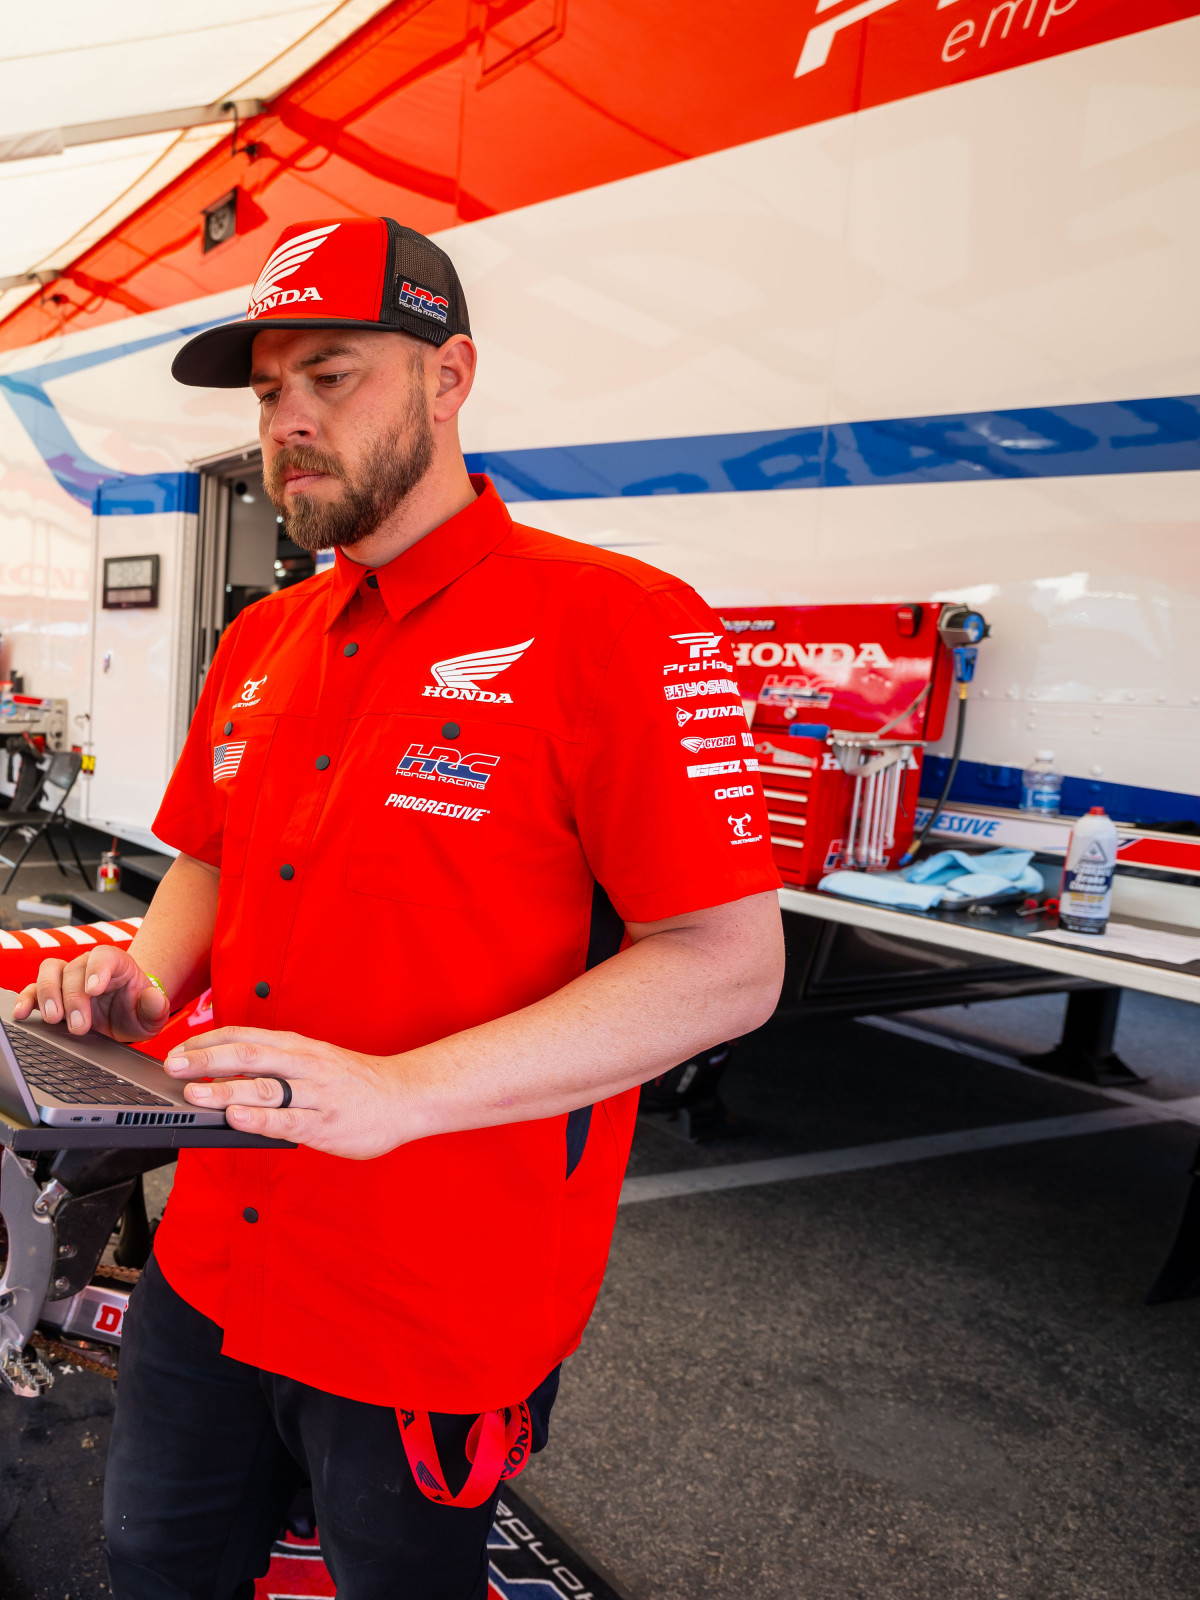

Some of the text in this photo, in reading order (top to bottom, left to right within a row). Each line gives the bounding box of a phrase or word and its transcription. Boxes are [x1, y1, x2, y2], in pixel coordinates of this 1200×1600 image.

[247, 286, 323, 319] ONDA
[399, 281, 449, 317] HRC
[664, 663, 701, 676] Pro
[422, 685, 514, 705] HONDA
[705, 736, 735, 748] CYCRA
[396, 743, 500, 784] HRC
[395, 770, 486, 790] Honda RACING
[714, 785, 755, 800] OGIO
[384, 793, 488, 822] PROGRESSIVE
